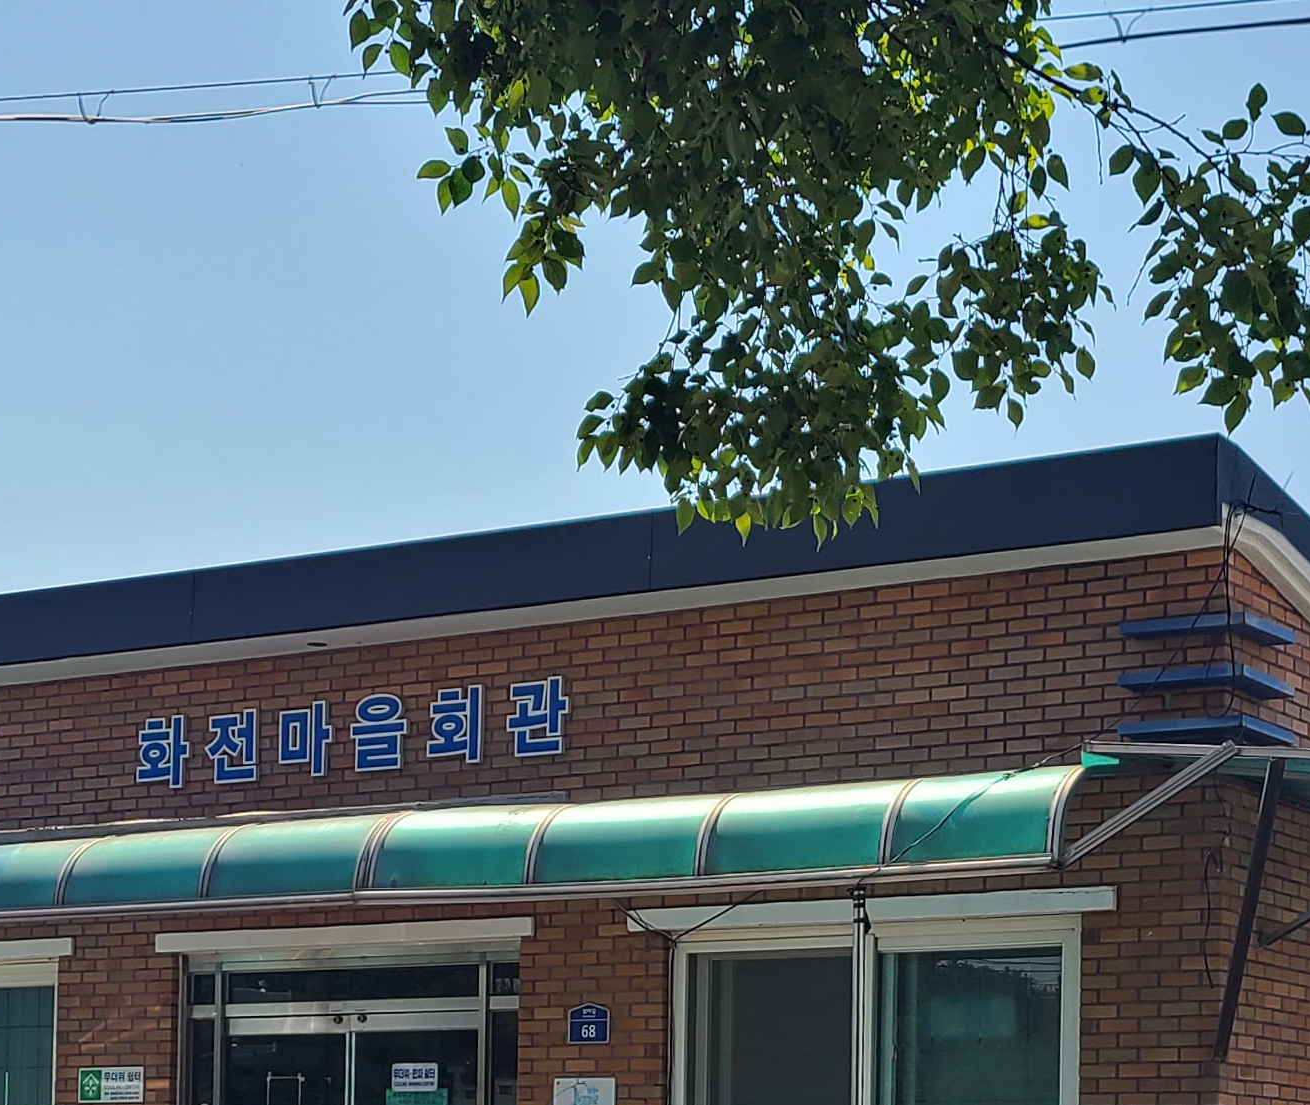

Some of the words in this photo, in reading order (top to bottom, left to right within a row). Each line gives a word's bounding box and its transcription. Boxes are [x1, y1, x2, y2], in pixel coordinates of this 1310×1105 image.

[135, 675, 569, 788] 화전마을회관
[581, 1024, 596, 1038] 68
[104, 1071, 125, 1082] 무더위
[128, 1071, 141, 1082] 쉼터
